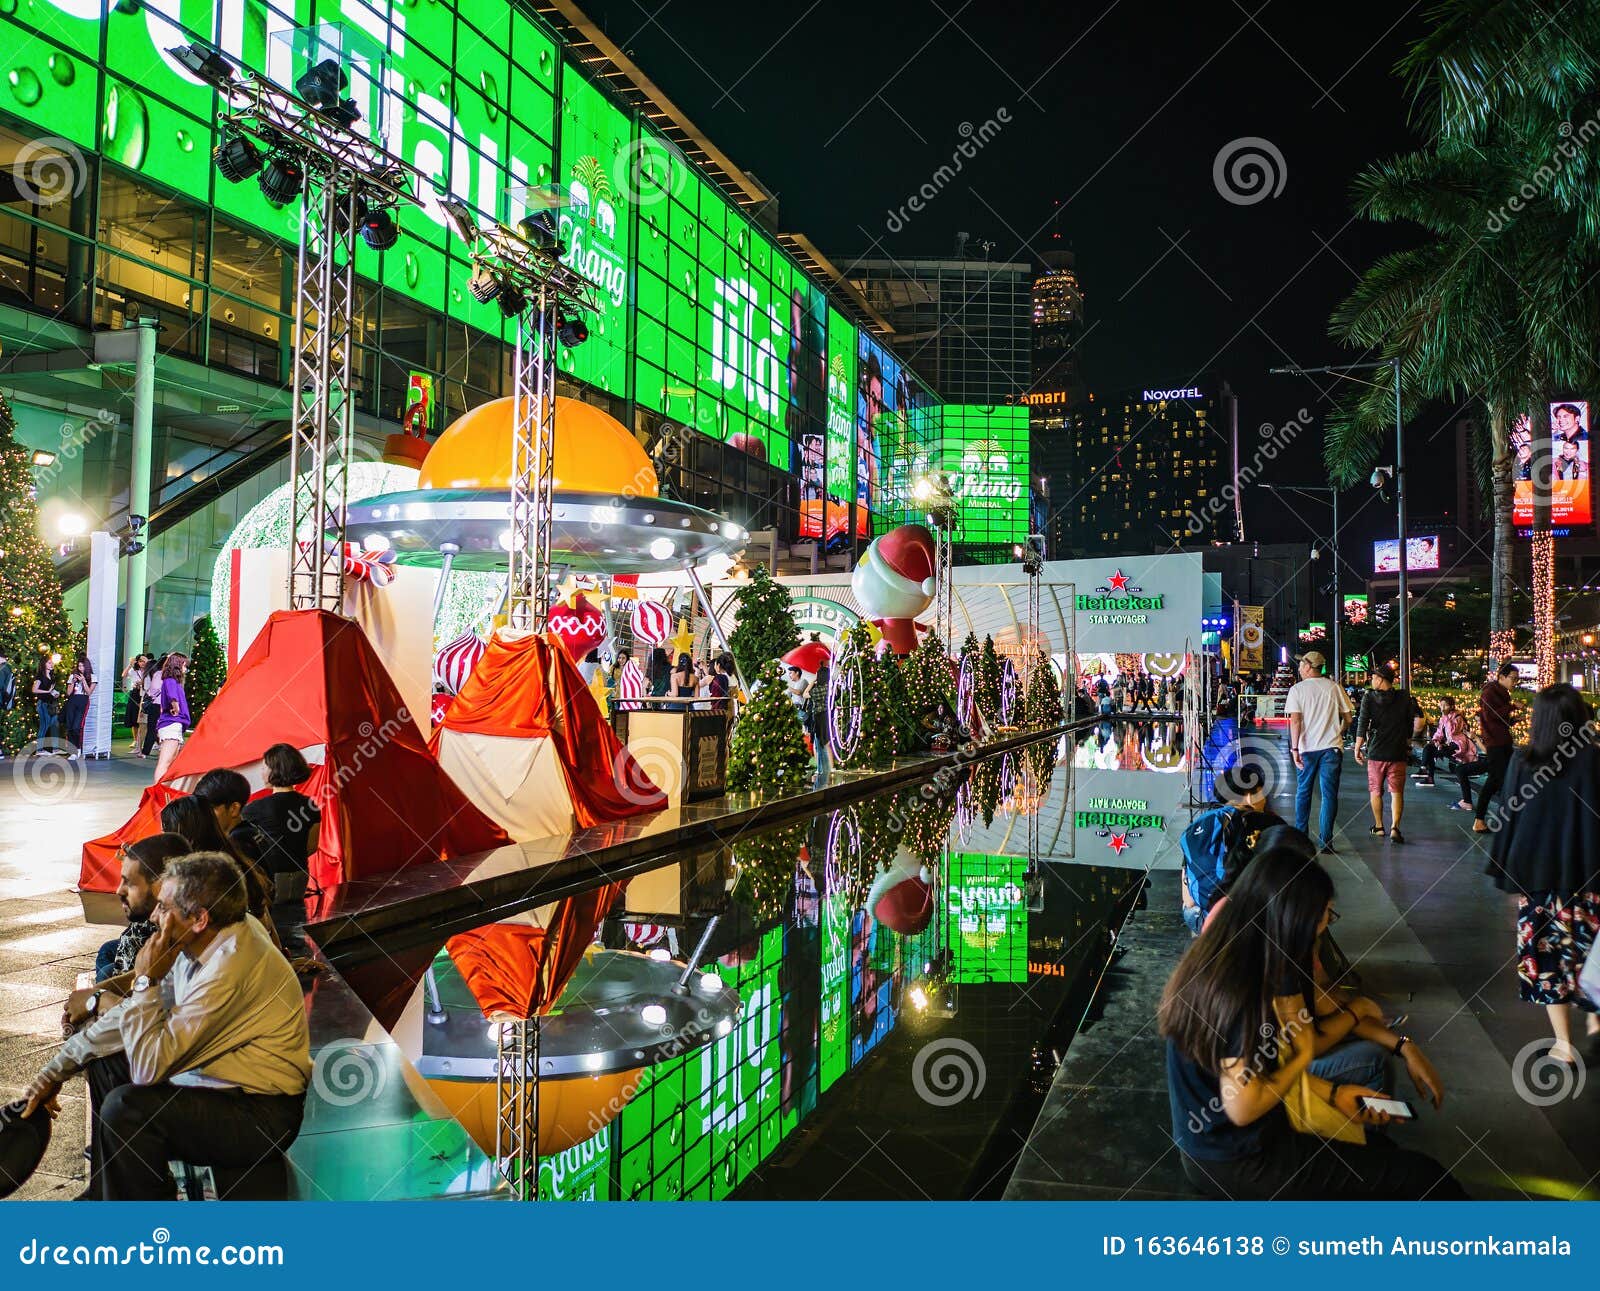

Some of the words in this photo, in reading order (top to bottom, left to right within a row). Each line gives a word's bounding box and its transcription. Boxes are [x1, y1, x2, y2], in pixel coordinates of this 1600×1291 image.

[1020, 391, 1066, 405] Amari
[1143, 387, 1203, 401] NOVOTEL
[1075, 593, 1164, 611] Heineken
[1089, 614, 1110, 624] STAR
[1111, 614, 1147, 624] VOYAGER
